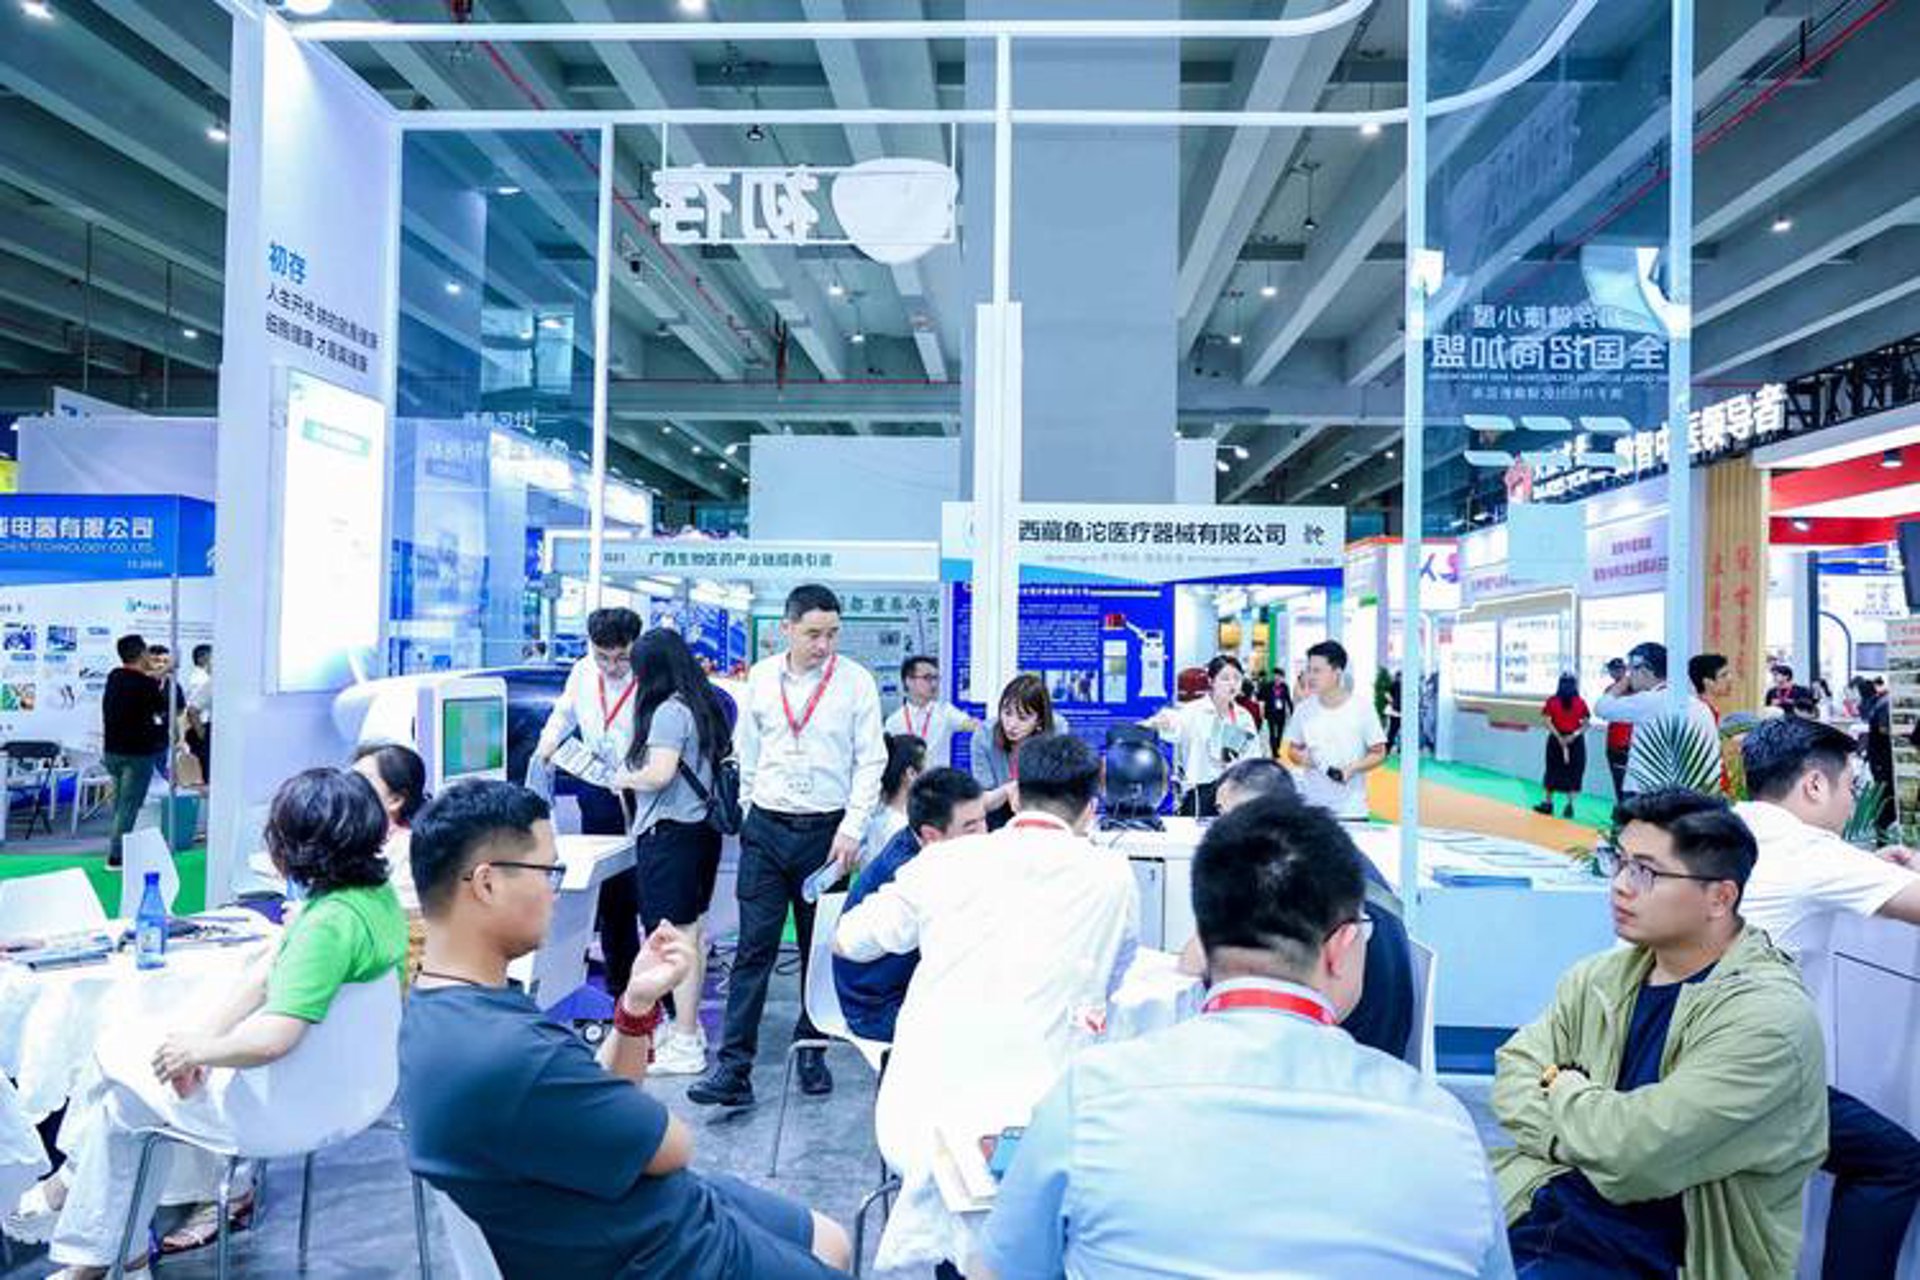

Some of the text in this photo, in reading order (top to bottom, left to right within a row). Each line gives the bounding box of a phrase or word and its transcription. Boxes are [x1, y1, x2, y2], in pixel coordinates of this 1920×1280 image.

[269, 241, 305, 285] 初存
[1018, 519, 1287, 546] 西藏鱼沱医疗器械有限公司
